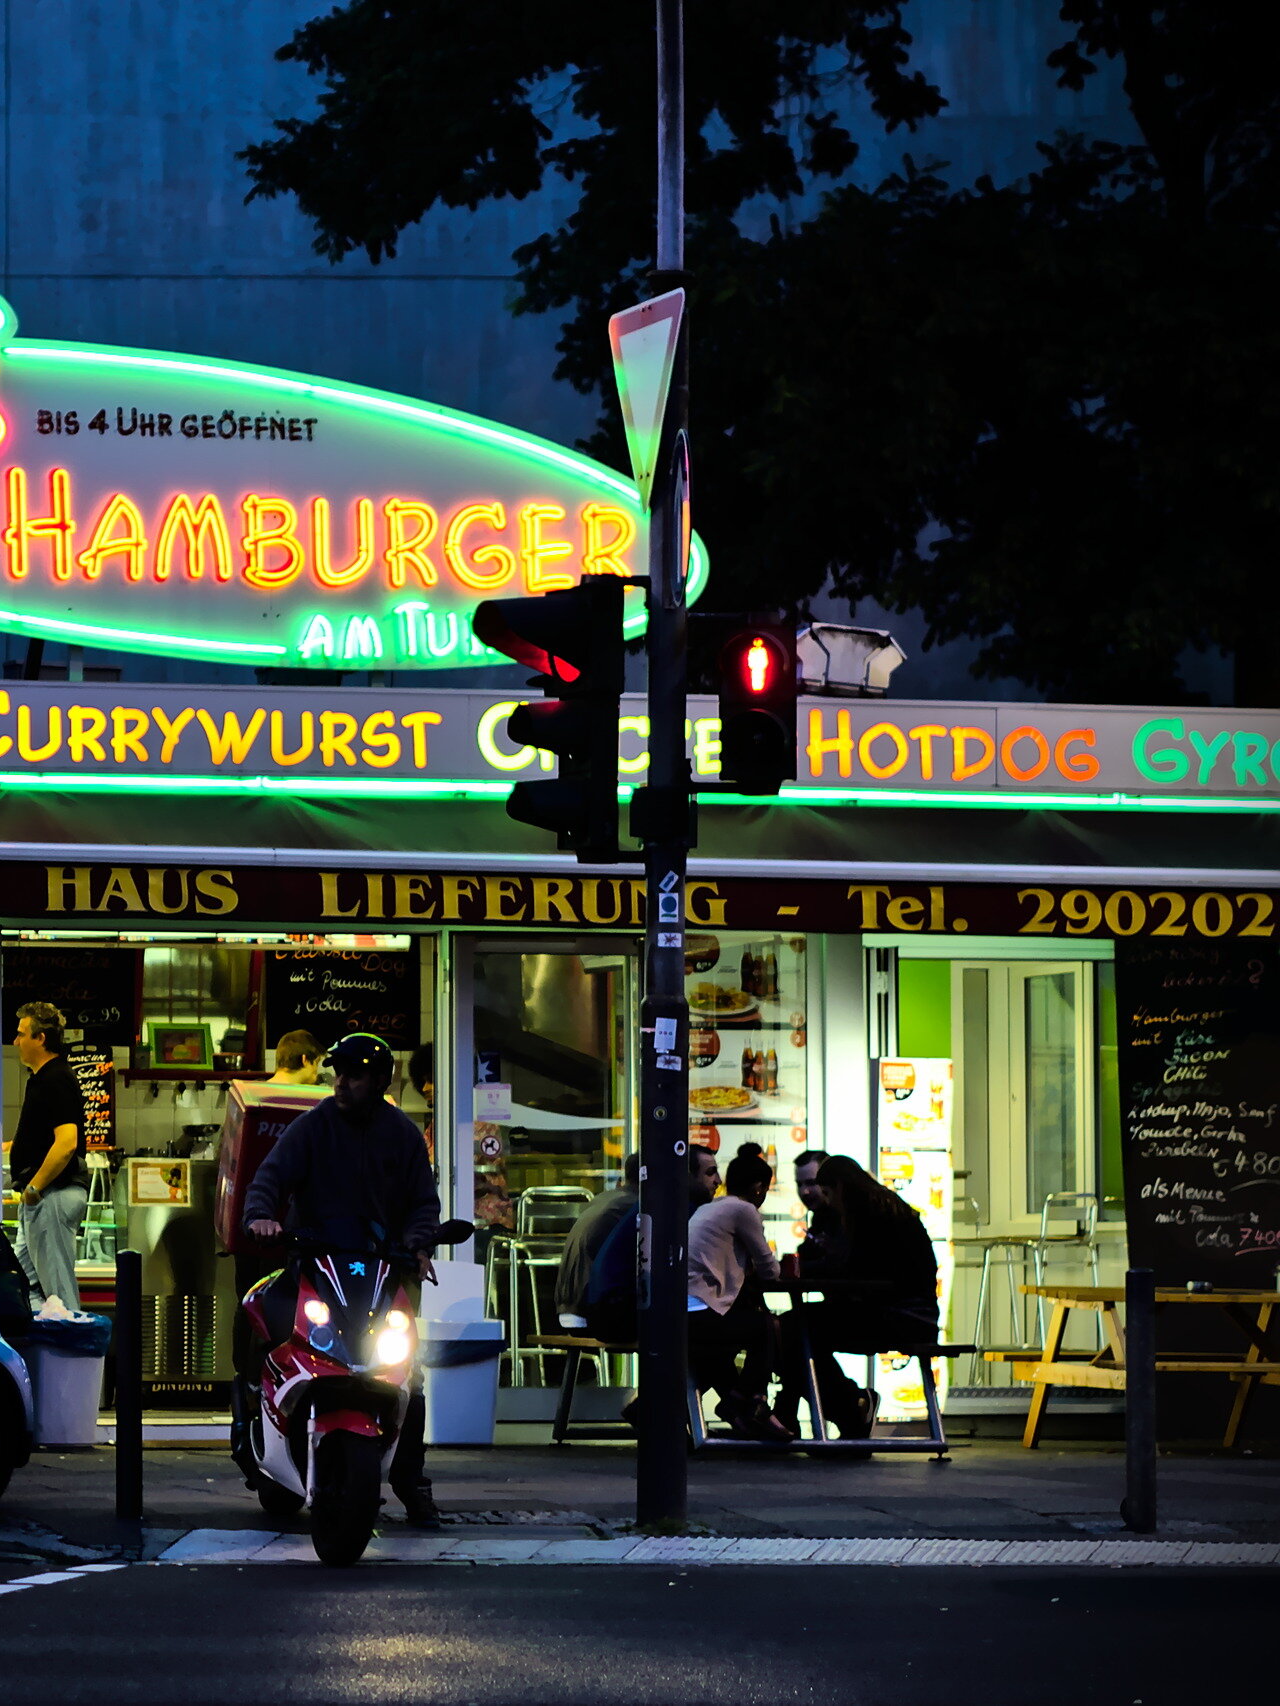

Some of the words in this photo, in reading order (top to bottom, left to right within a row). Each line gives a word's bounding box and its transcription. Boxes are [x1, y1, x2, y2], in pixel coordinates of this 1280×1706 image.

[36, 408, 81, 436] BIS
[87, 408, 110, 435] 4
[116, 406, 173, 437] UHR
[179, 409, 319, 442] GEÖFFNET
[2, 466, 637, 593] HAMBURGER
[298, 613, 384, 660] AM
[806, 707, 1101, 783] HOTDOG
[1131, 717, 1280, 787] GYR
[45, 866, 239, 916] HAUS
[847, 884, 968, 933] Tel.
[1017, 887, 1275, 938] 290202
[1131, 1004, 1238, 1028] Hamburger
